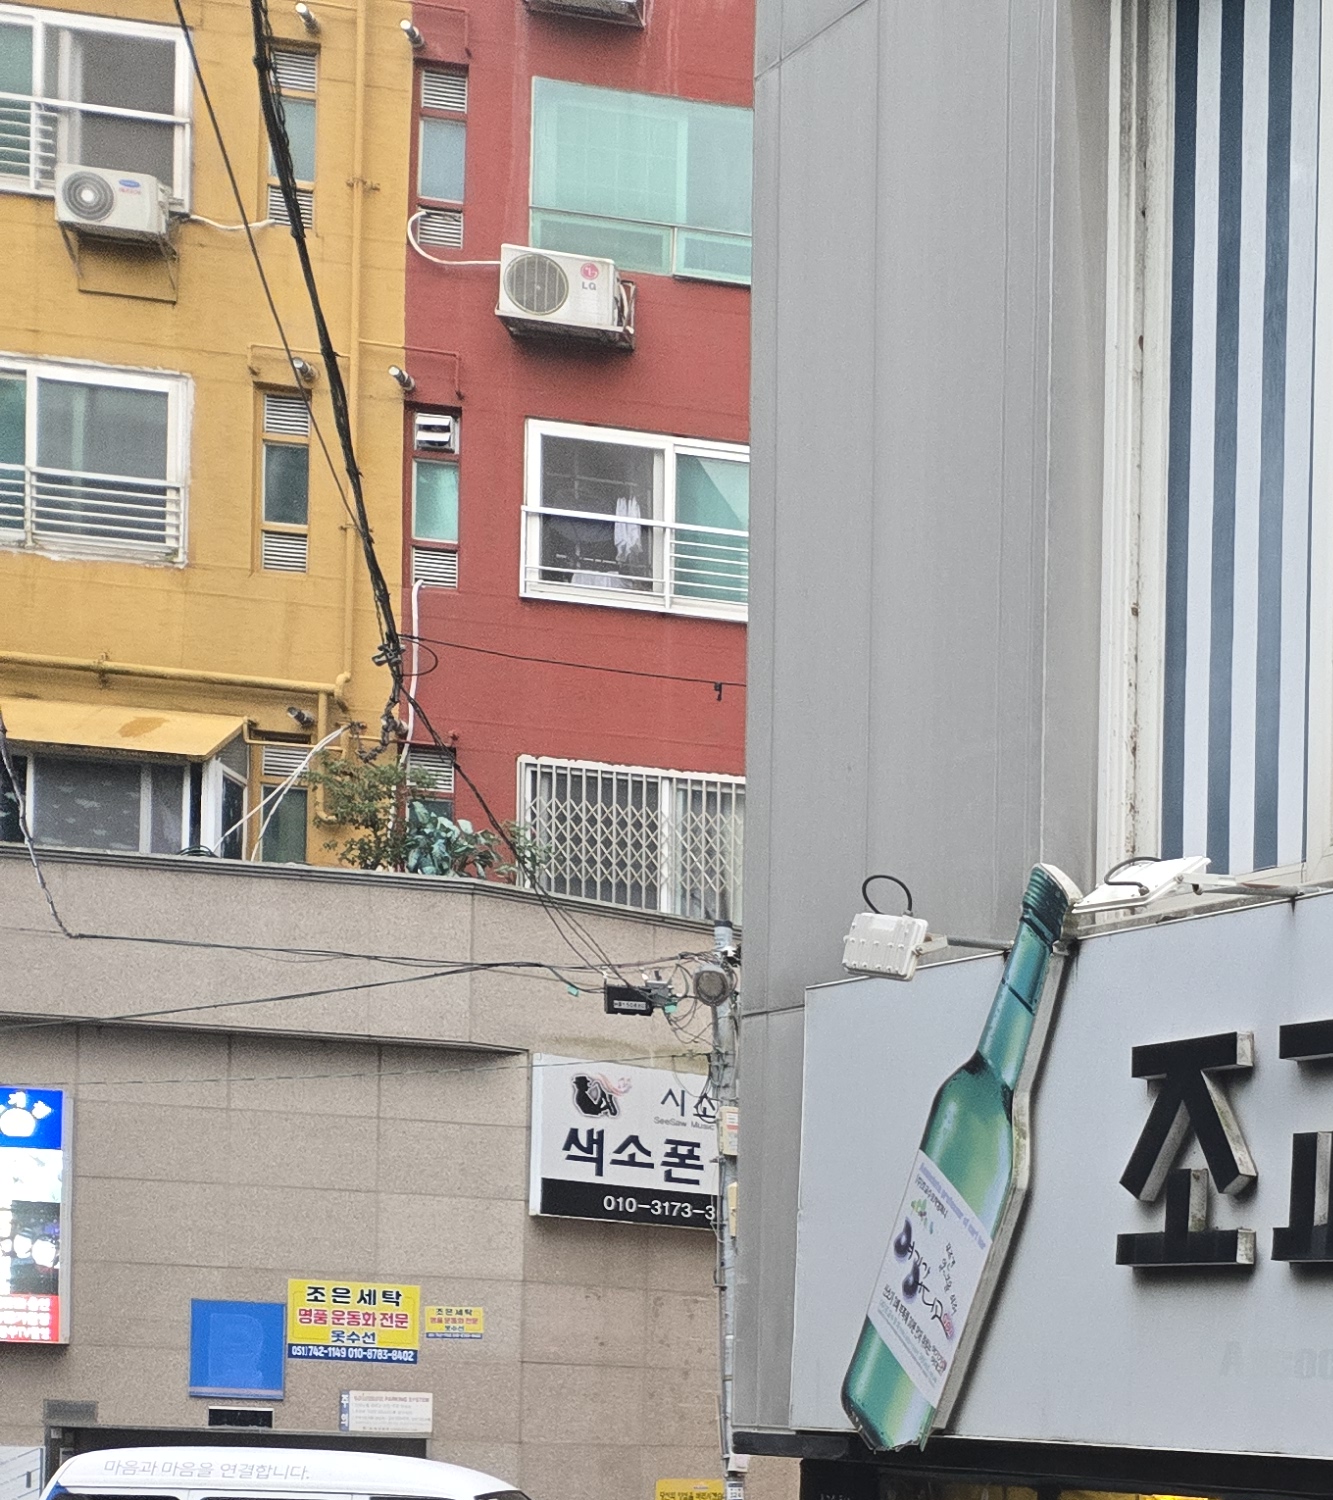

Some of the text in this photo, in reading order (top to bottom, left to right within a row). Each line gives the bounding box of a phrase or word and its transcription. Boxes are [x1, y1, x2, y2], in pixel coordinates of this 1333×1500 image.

[561, 1127, 704, 1186] 색소폰
[299, 1308, 409, 1329] 명품 운동화 전문
[331, 1330, 376, 1345] 옷수선
[104, 1460, 158, 1476] 마음과
[162, 1461, 214, 1478] 마음을
